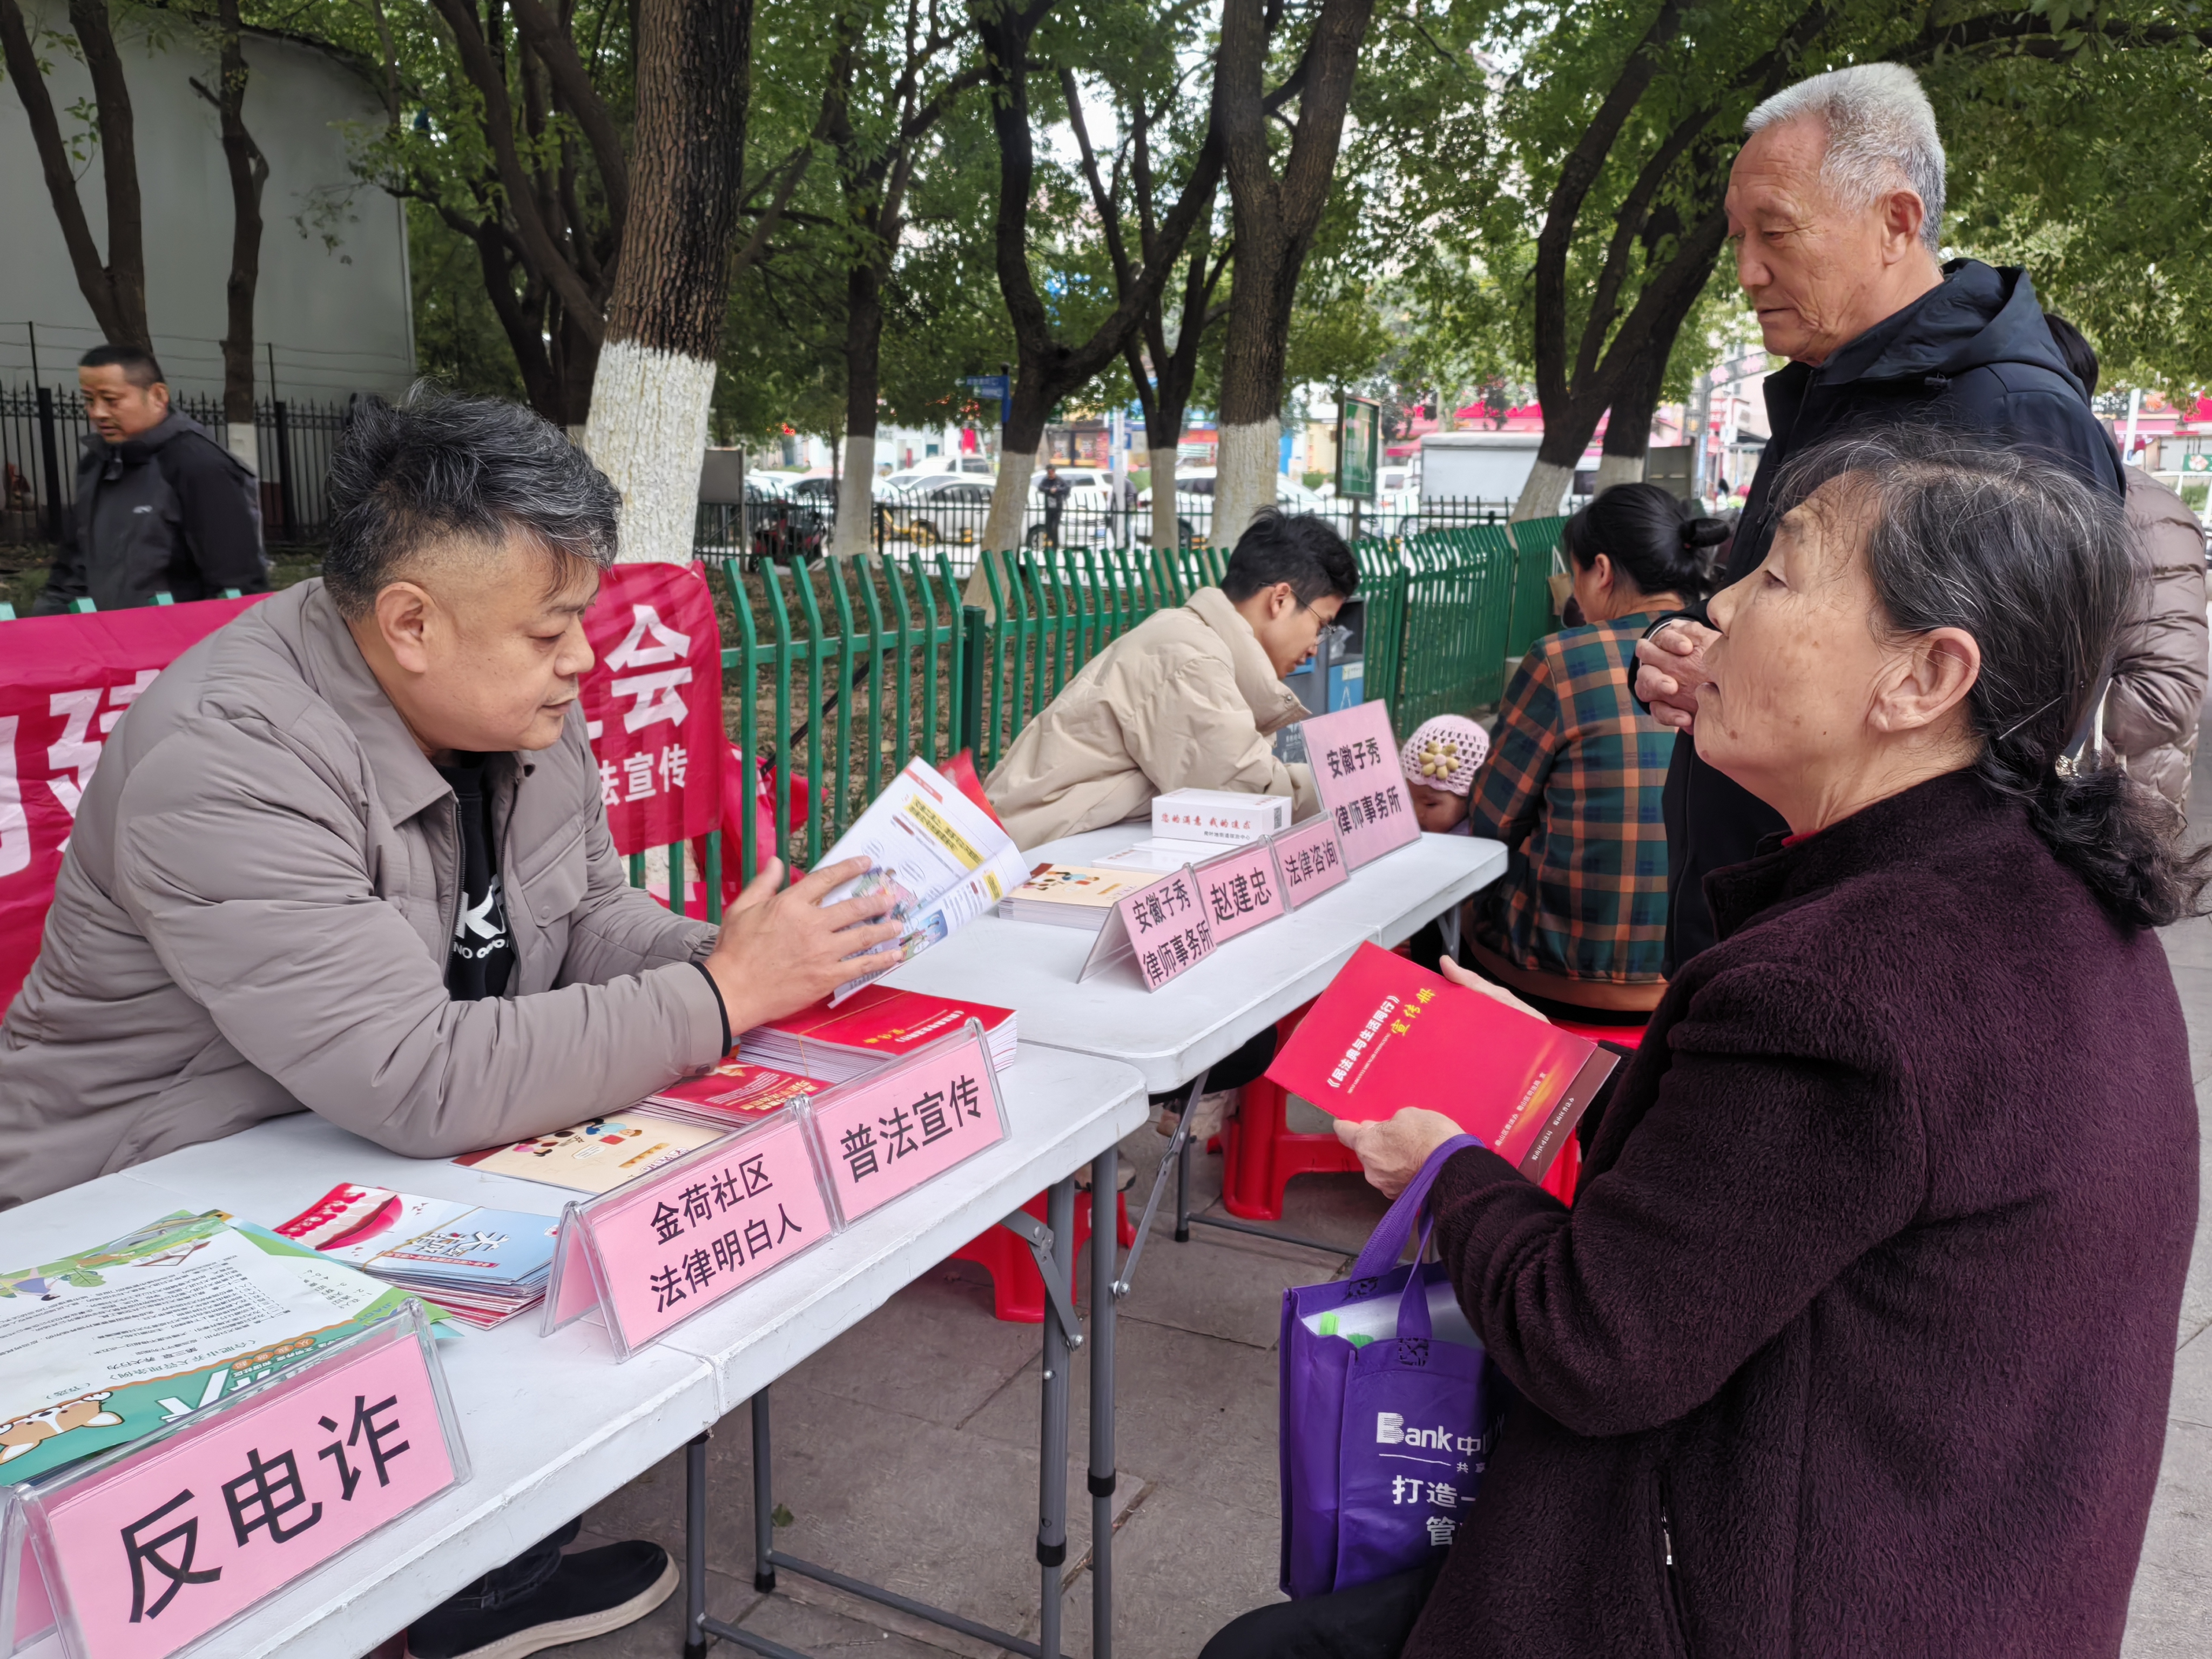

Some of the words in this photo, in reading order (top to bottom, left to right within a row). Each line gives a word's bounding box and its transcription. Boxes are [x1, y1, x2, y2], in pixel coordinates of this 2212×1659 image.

[586, 604, 692, 744] 会
[1326, 737, 1381, 779] 安徽子秀
[1335, 786, 1401, 836] 律师事务所
[1284, 838, 1338, 888] 法律咨询
[1132, 879, 1191, 934] 安徽子秀
[1210, 867, 1272, 925] 赵建忠
[1143, 920, 1213, 986] 律师事务所
[1391, 988, 1435, 1036] 宣传册
[1326, 995, 1400, 1088] 《民法典与生活同行》
[840, 1074, 981, 1183] 普法宣传
[650, 1154, 773, 1245] 金荷社区
[650, 1203, 801, 1312] 法律明白人
[1377, 1412, 1453, 1452] Bank
[1458, 1434, 1489, 1456] 中
[120, 1395, 410, 1623] 反电诈
[1426, 1516, 1464, 1547] 管
